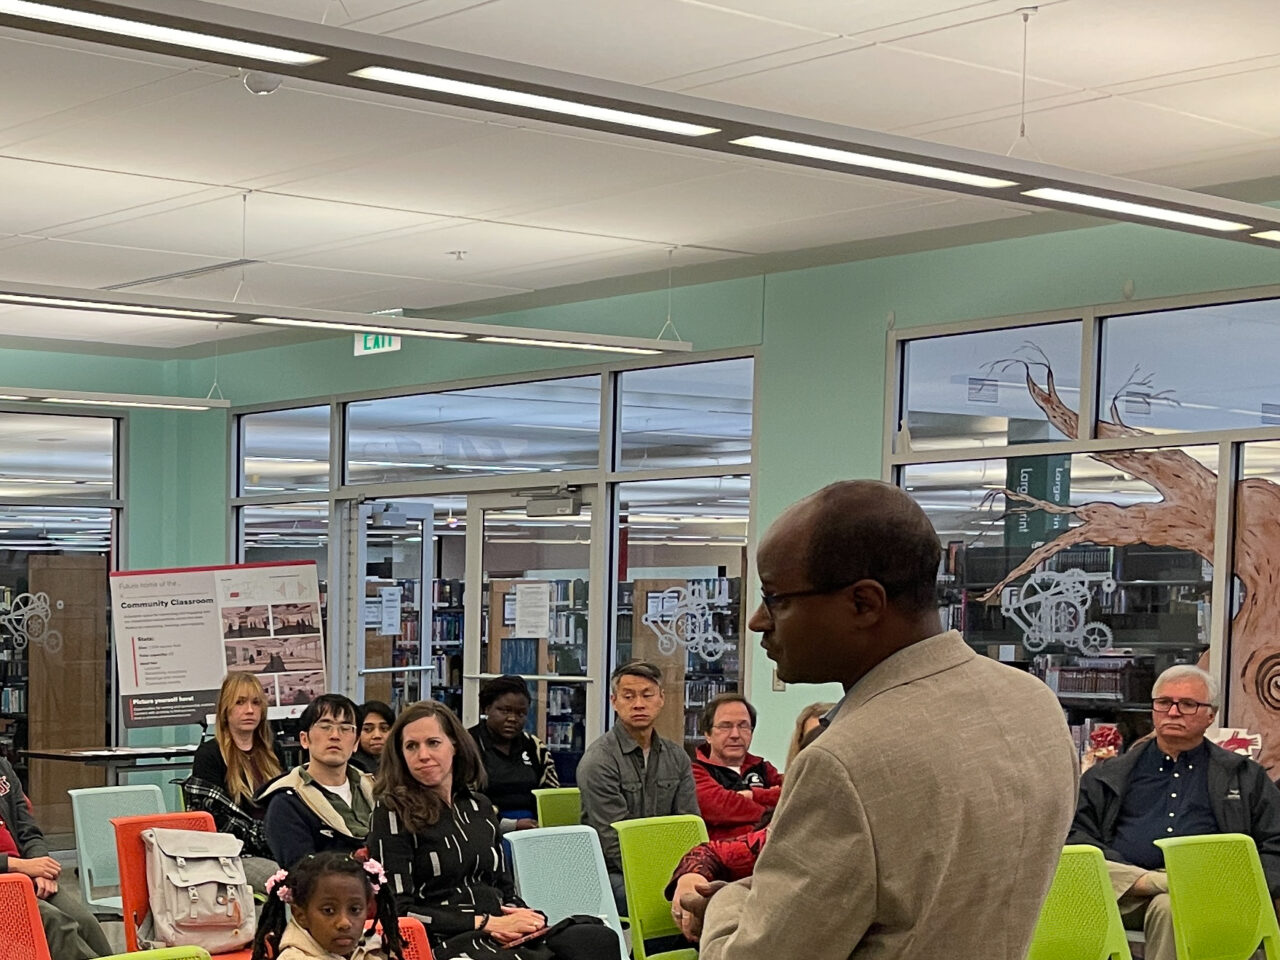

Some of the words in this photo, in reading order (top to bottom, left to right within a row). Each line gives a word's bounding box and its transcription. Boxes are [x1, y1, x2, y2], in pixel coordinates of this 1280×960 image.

[1017, 468, 1033, 494] Larg
[1053, 468, 1063, 502] Large
[120, 600, 169, 609] Community
[170, 598, 214, 606] Classroom
